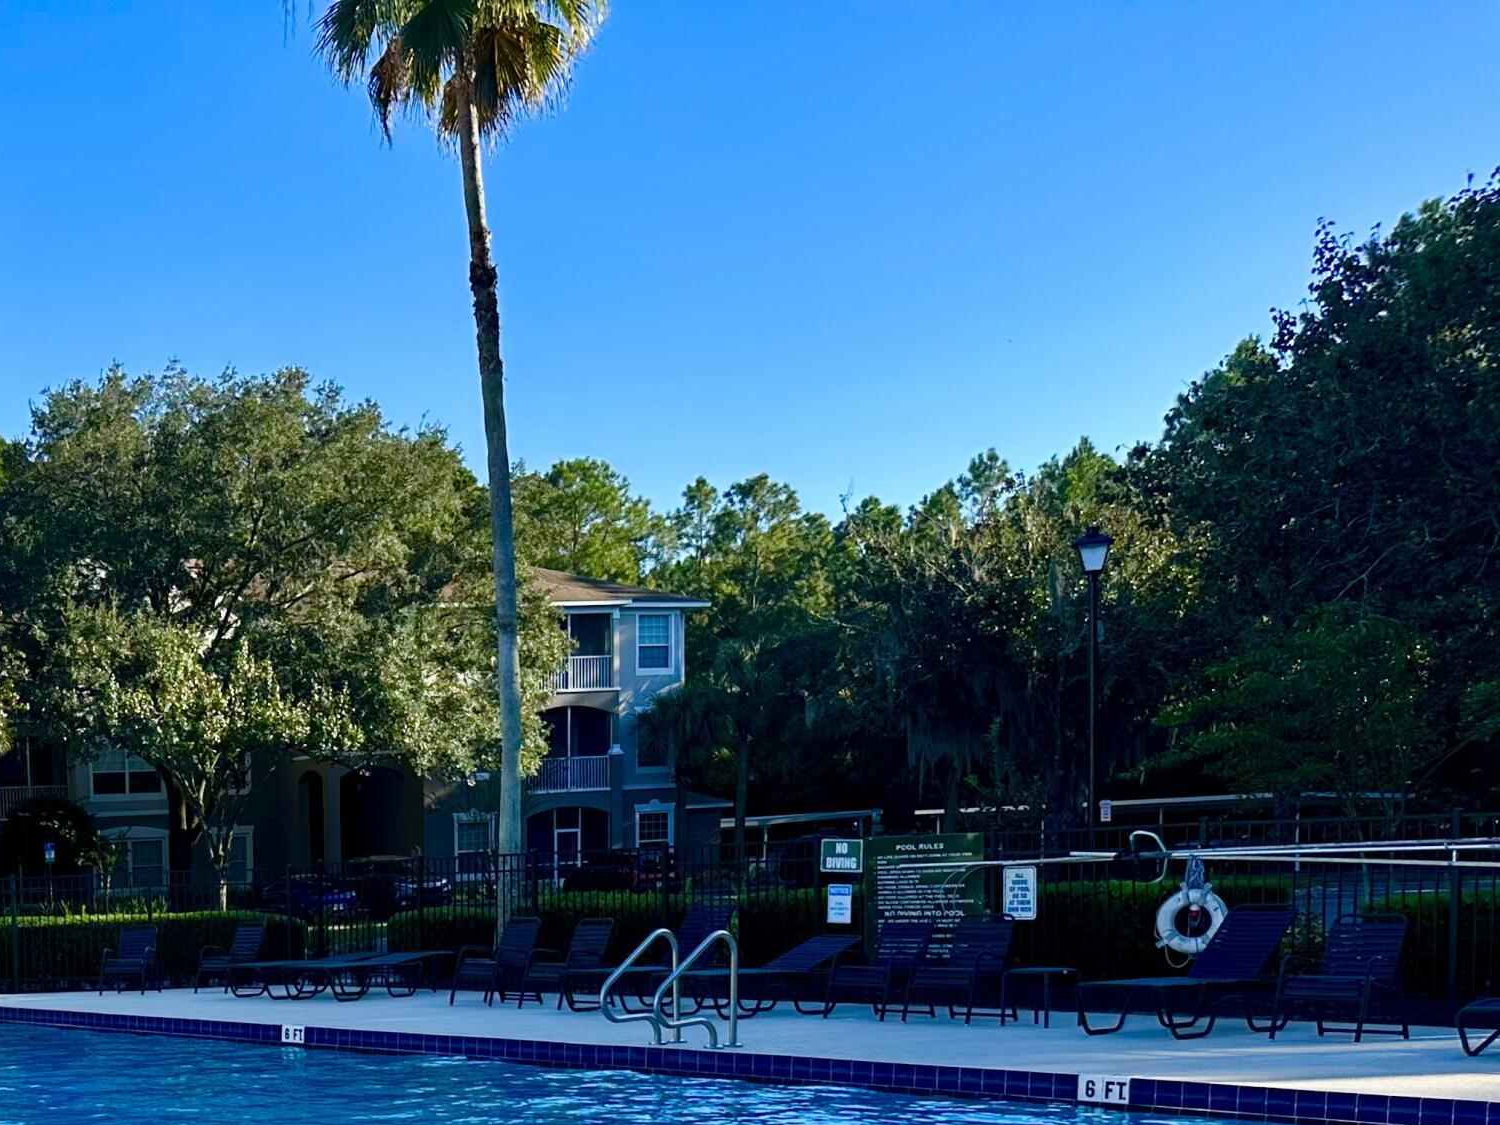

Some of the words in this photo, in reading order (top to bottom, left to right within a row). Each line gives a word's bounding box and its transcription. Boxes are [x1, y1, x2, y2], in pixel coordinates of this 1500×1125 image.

[835, 842, 848, 854] NO
[918, 842, 944, 850] RULES
[826, 857, 857, 869] DIVING
[284, 1027, 290, 1040] 6
[1085, 1079, 1096, 1098] 6
